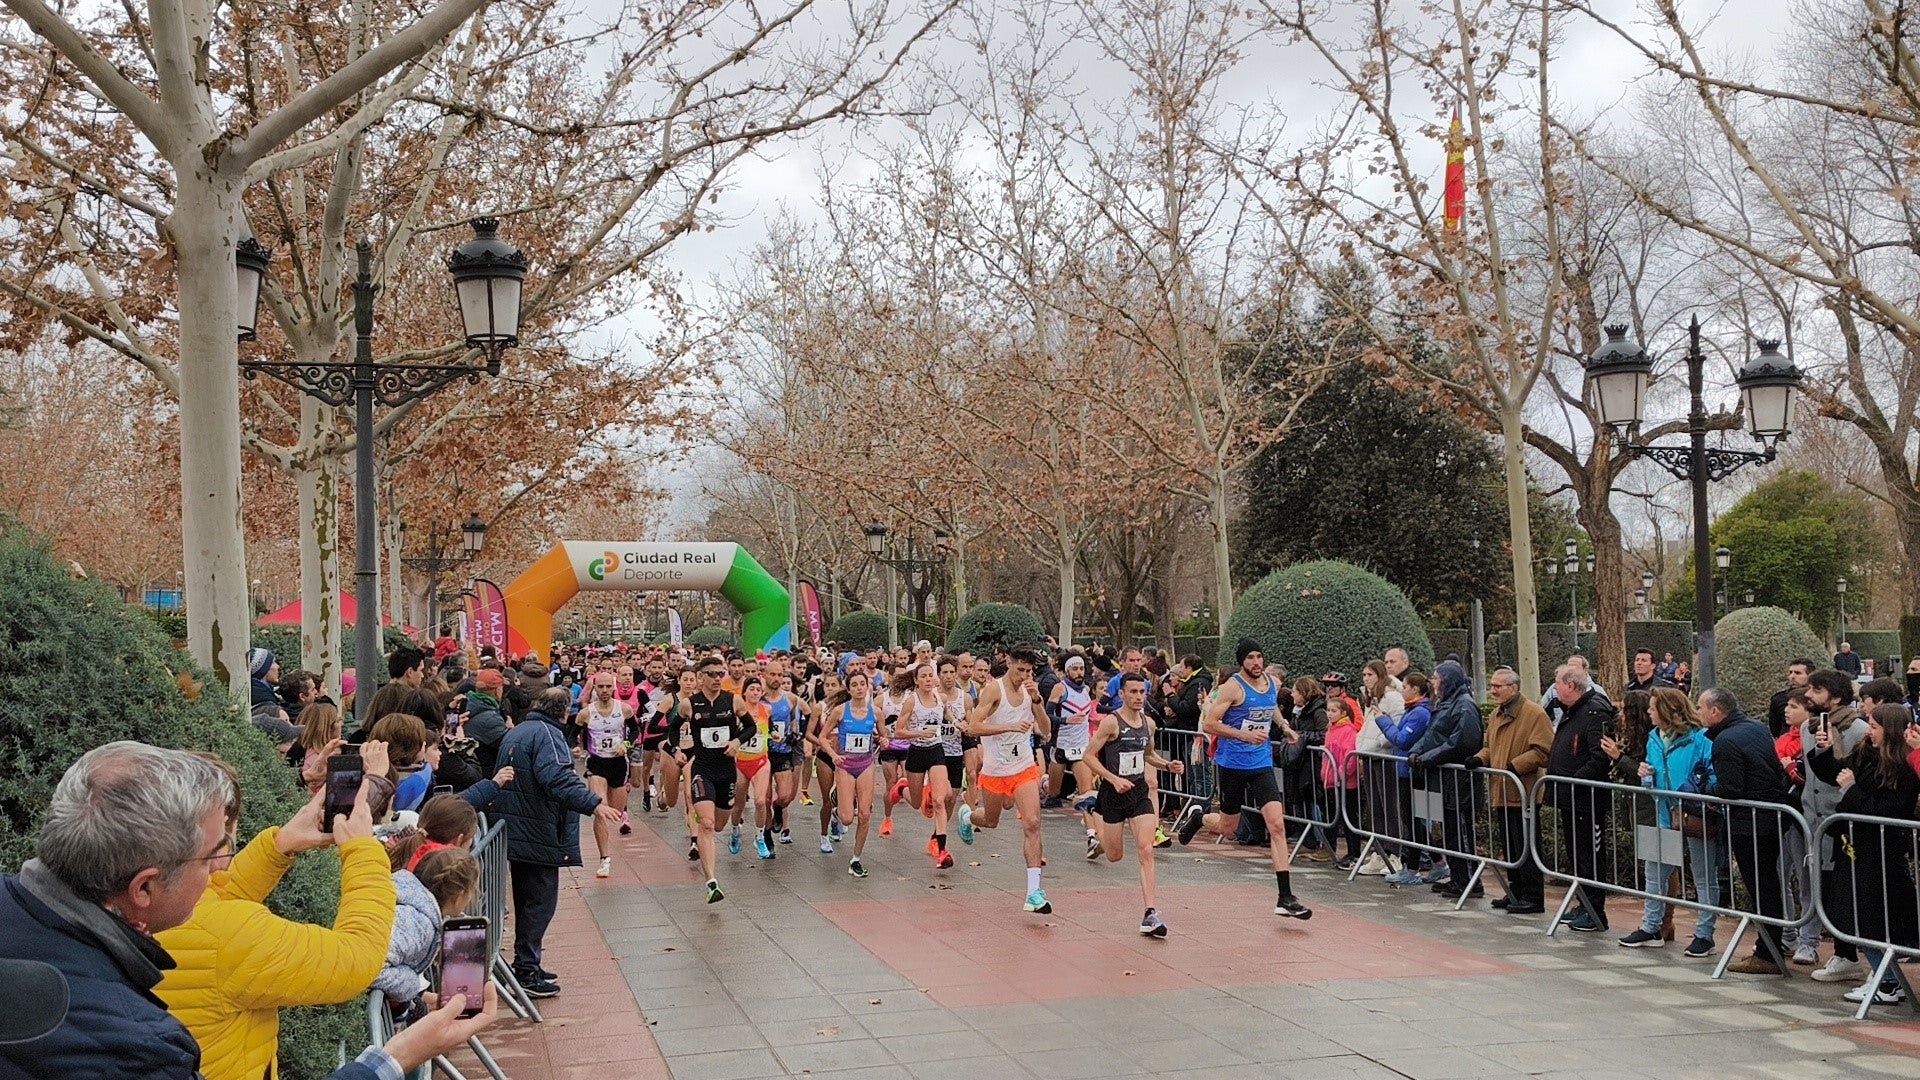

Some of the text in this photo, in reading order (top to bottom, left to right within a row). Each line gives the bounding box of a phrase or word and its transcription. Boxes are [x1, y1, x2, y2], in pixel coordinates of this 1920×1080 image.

[624, 552, 716, 564] Ciudad Real
[624, 568, 683, 581] Deporte
[712, 730, 720, 742] 6
[940, 726, 955, 736] 319
[601, 738, 613, 749] 57
[746, 737, 758, 748] 12
[854, 736, 863, 748] 11
[1011, 744, 1019, 757] 4
[1132, 755, 1138, 769] 1
